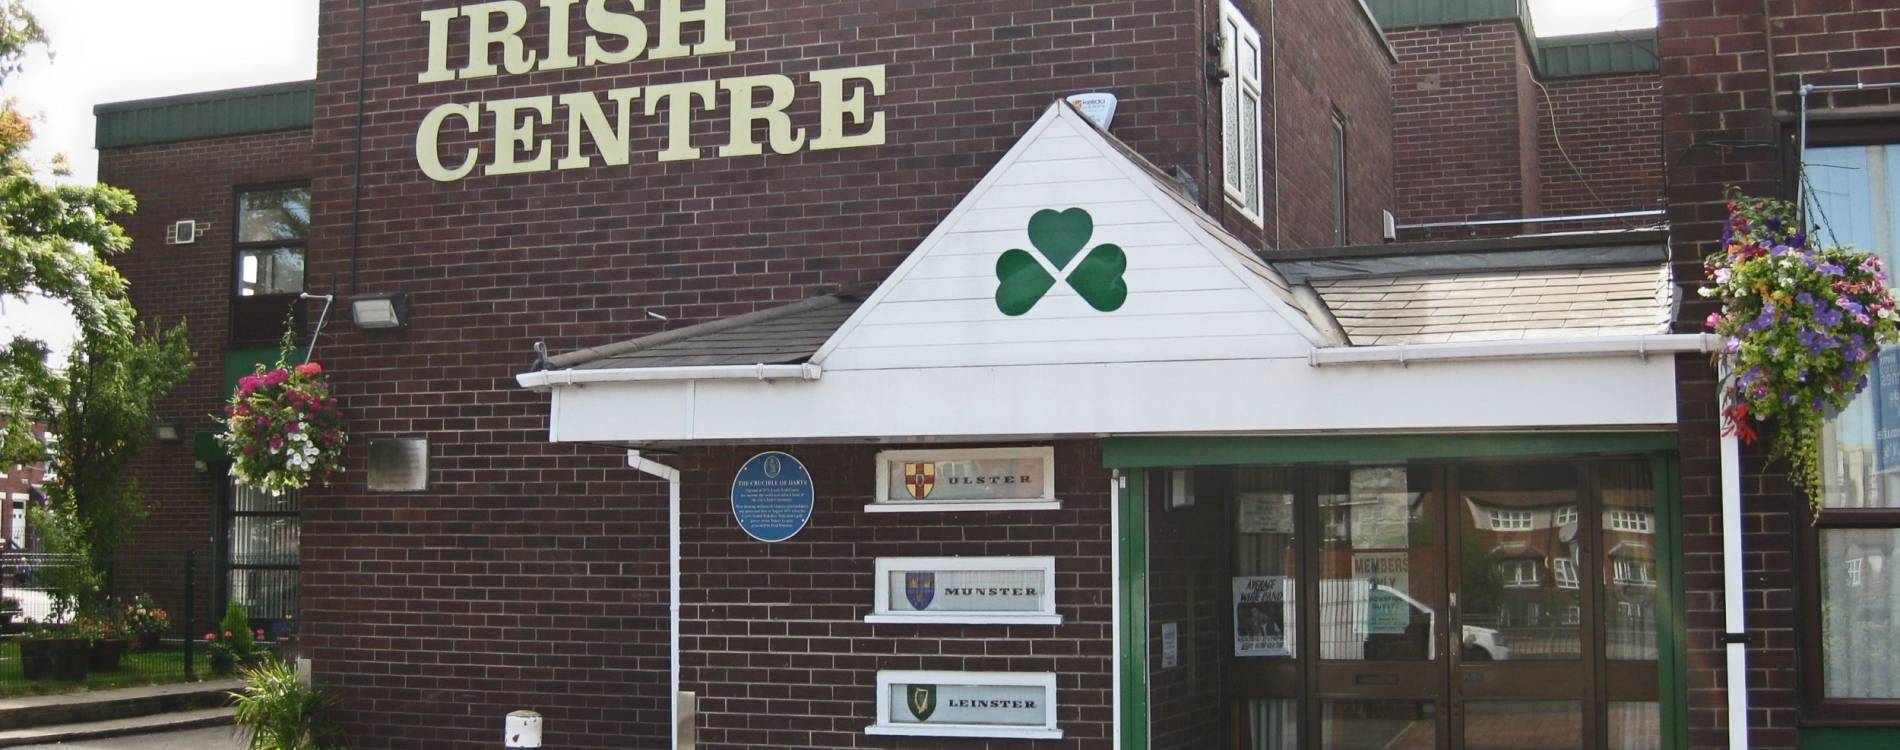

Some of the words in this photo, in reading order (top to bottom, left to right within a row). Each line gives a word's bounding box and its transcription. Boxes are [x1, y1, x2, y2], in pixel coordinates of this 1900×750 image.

[418, 0, 736, 84] IRISH
[415, 64, 887, 182] CENTRE
[949, 475, 1032, 484] ULSTER
[1354, 557, 1408, 573] MEMBERS
[944, 588, 1038, 596] MUNSTER
[949, 699, 1036, 708] LEINSTER
